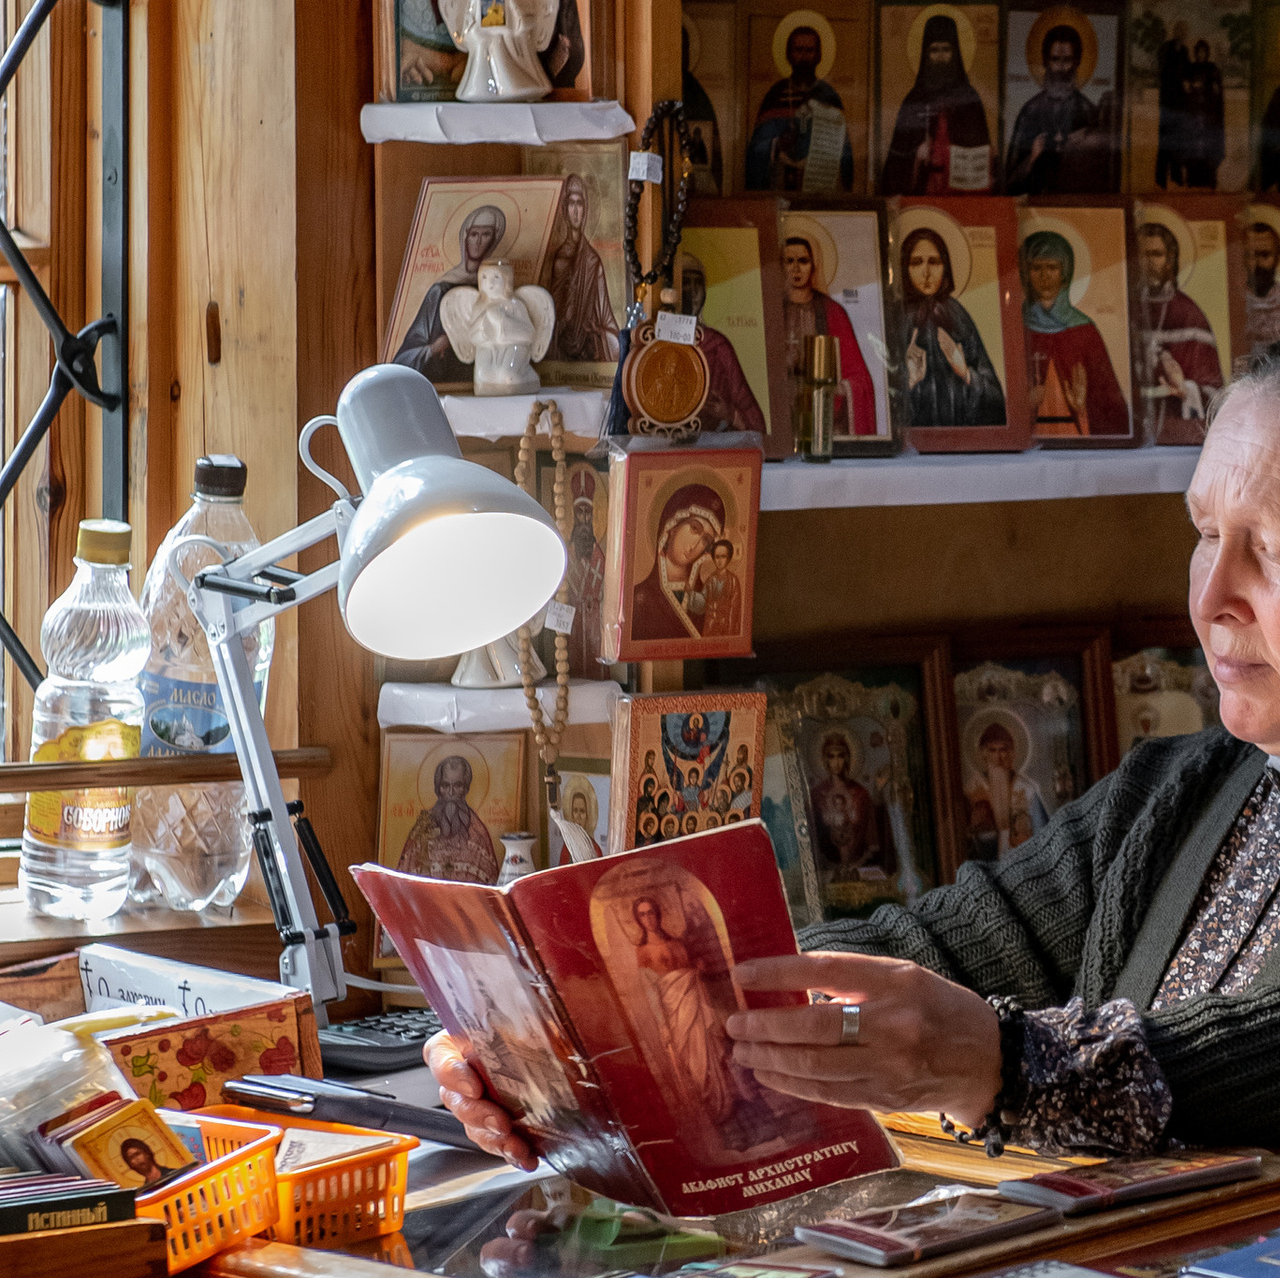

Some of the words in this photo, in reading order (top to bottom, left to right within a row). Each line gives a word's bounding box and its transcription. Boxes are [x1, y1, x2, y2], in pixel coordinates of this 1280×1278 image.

[170, 688, 216, 706] МАСЛО
[682, 1174, 743, 1193] АКАФИСТ
[748, 1140, 859, 1182] АРХИСТРАТИГУ
[742, 1169, 812, 1197] МИХАИЛУ
[27, 1201, 108, 1232] Истинный
